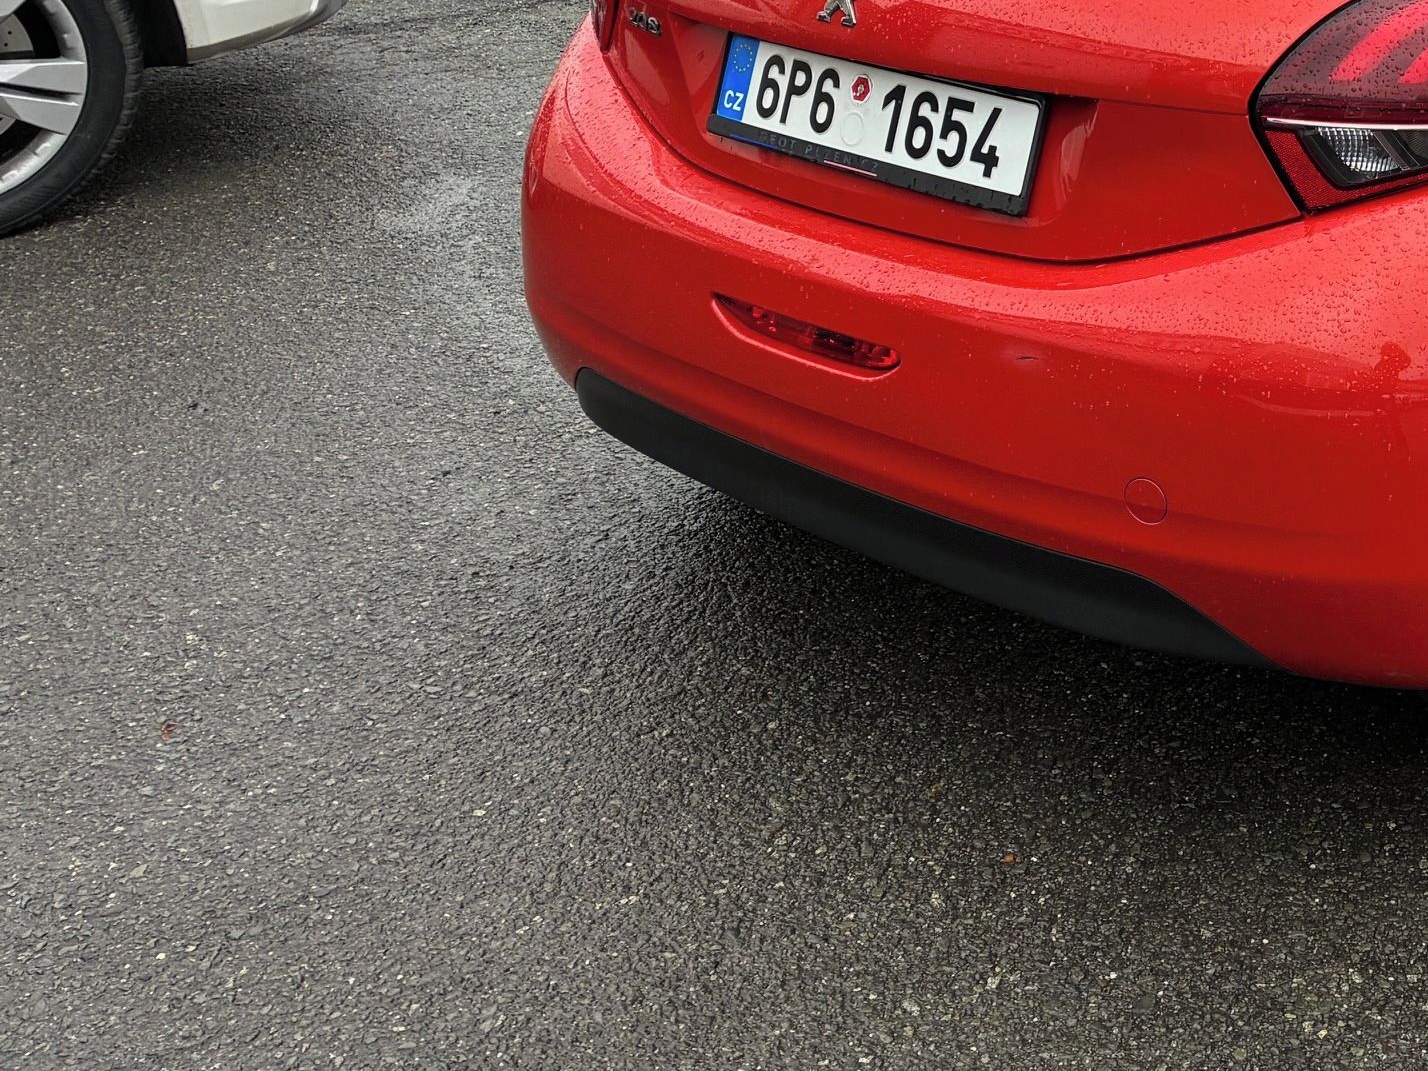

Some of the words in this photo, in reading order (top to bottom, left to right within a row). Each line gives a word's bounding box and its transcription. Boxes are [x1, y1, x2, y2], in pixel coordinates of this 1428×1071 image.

[723, 89, 744, 112] CZ
[756, 54, 841, 134] 6P6
[881, 84, 1003, 178] 1654
